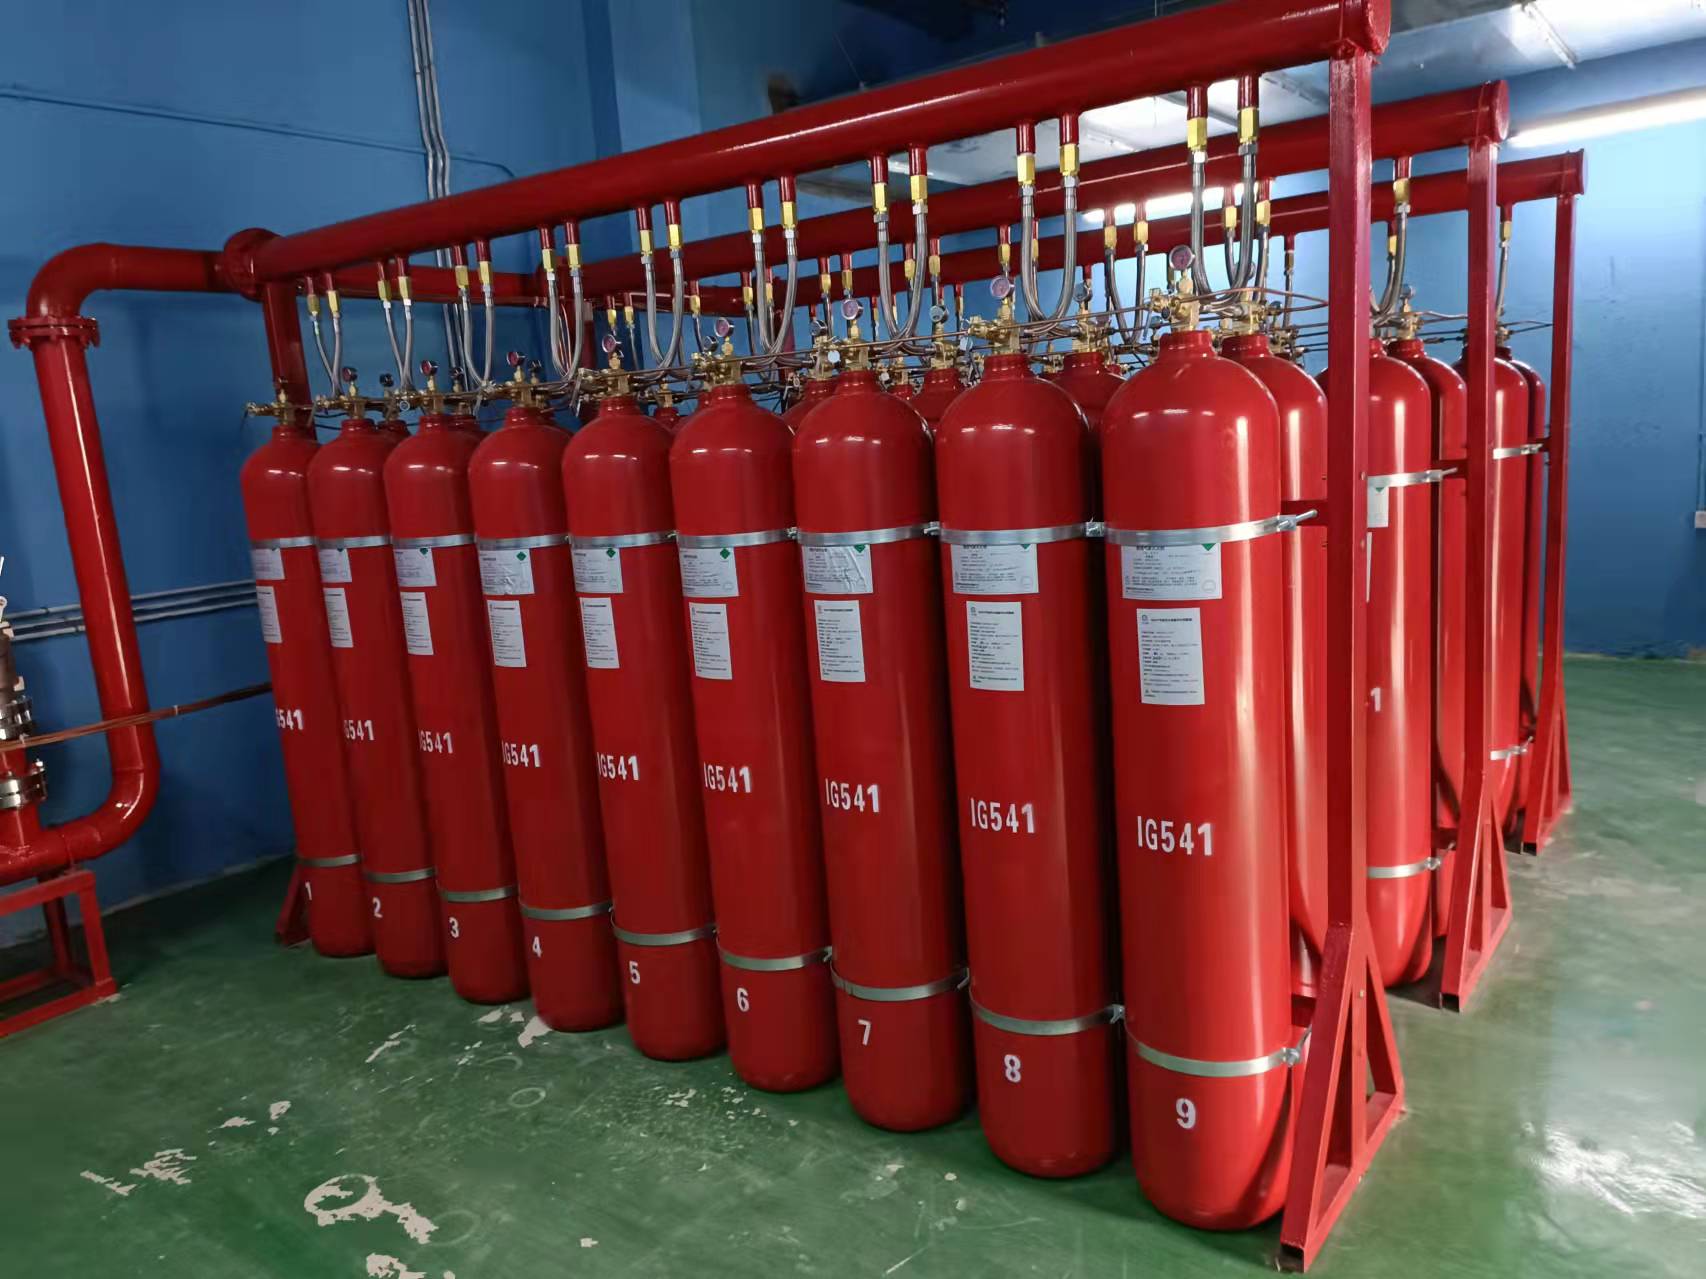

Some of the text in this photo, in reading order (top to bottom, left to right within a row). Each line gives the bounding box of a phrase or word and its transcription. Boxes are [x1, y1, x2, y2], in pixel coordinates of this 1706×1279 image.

[501, 740, 541, 768] IG541
[596, 751, 639, 781] IG541
[702, 762, 751, 794] IG541
[824, 778, 881, 814] IG541
[969, 797, 1036, 835] IG541
[1136, 814, 1214, 858] IG541
[372, 897, 384, 919] 2
[449, 916, 461, 940] 3
[532, 936, 543, 959] 4
[629, 960, 642, 986] 5
[736, 986, 751, 1013] 6
[858, 1018, 872, 1047] 7
[1003, 1053, 1023, 1084] 8
[1175, 1097, 1198, 1130] 9
